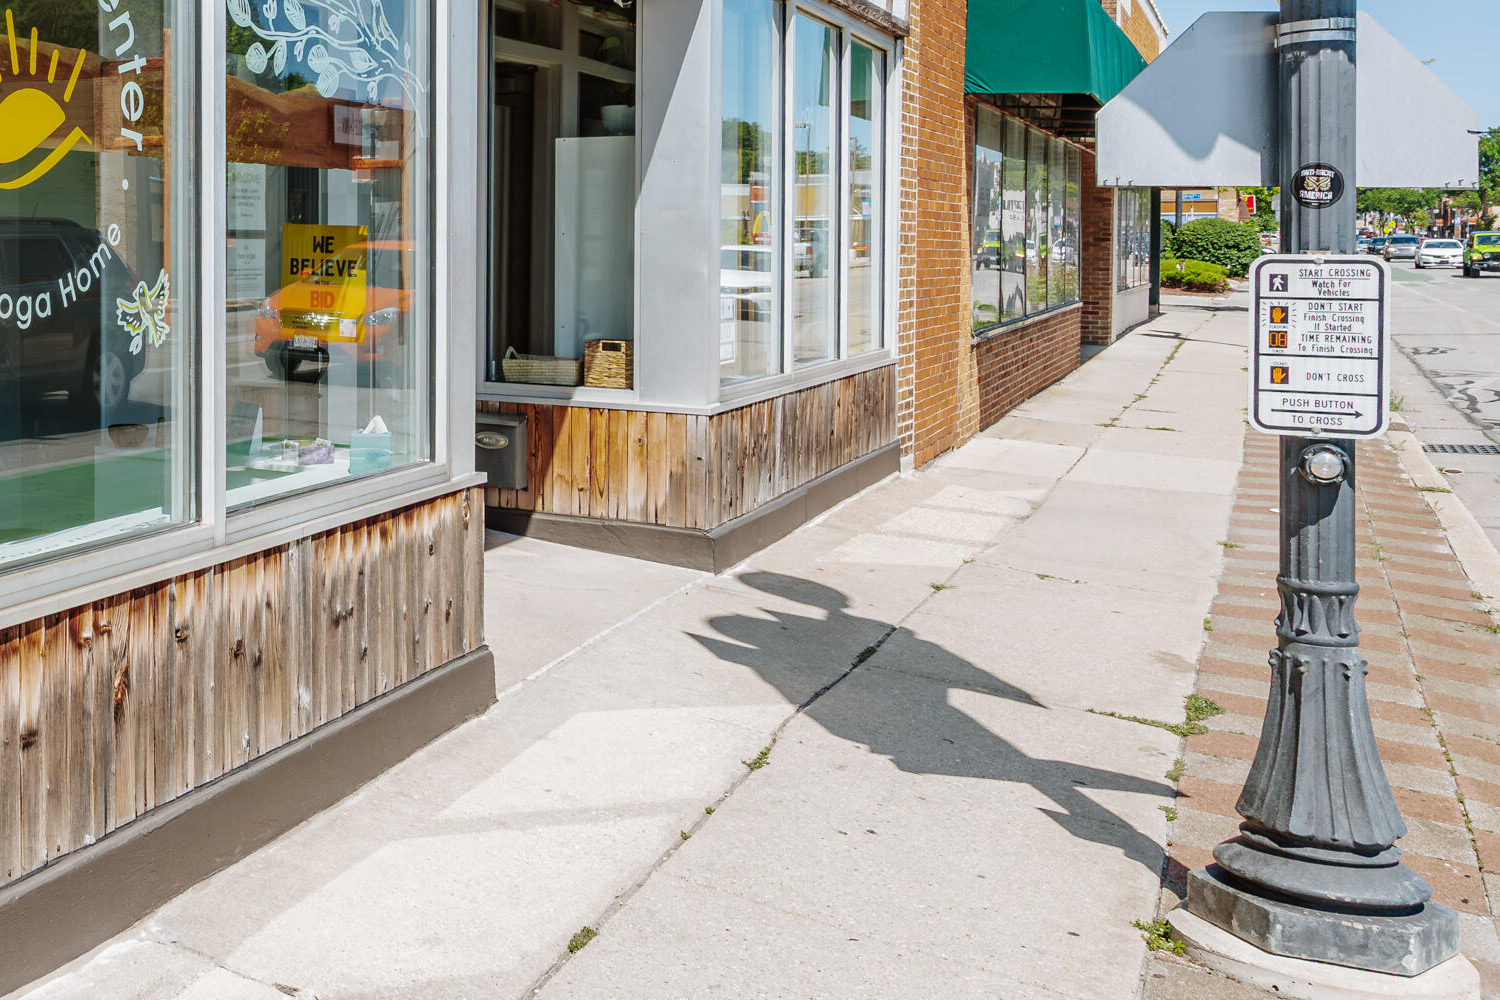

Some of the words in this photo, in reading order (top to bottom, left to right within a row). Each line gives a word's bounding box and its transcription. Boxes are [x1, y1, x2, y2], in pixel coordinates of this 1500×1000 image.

[1300, 190, 1332, 199] AMERICA
[312, 235, 334, 253] WE
[58, 222, 122, 308] Home
[290, 257, 357, 278] BELIEVE
[1299, 268, 1323, 277] START
[1328, 268, 1371, 277] CROSSING
[1312, 280, 1335, 288] Watch
[1317, 288, 1350, 296] Vehicles
[310, 290, 335, 308] BID
[1308, 302, 1332, 310] DON'T
[1338, 303, 1363, 311] START
[1303, 313, 1327, 321] Finish
[1331, 313, 1365, 325] Crossing
[1314, 322, 1320, 330] If
[1324, 323, 1352, 331] Started
[1301, 334, 1320, 342] TIME
[1325, 334, 1372, 343] REMAINING
[1297, 343, 1306, 351] To
[1311, 344, 1335, 352] Finish
[1340, 345, 1373, 356] Crossing
[1306, 372, 1331, 382] DON'T
[1337, 373, 1365, 382] CROSS
[1282, 398, 1310, 407] PUSH
[1314, 399, 1354, 409] BUTTON
[1292, 415, 1304, 424] TO
[1309, 416, 1343, 426] CROSS
